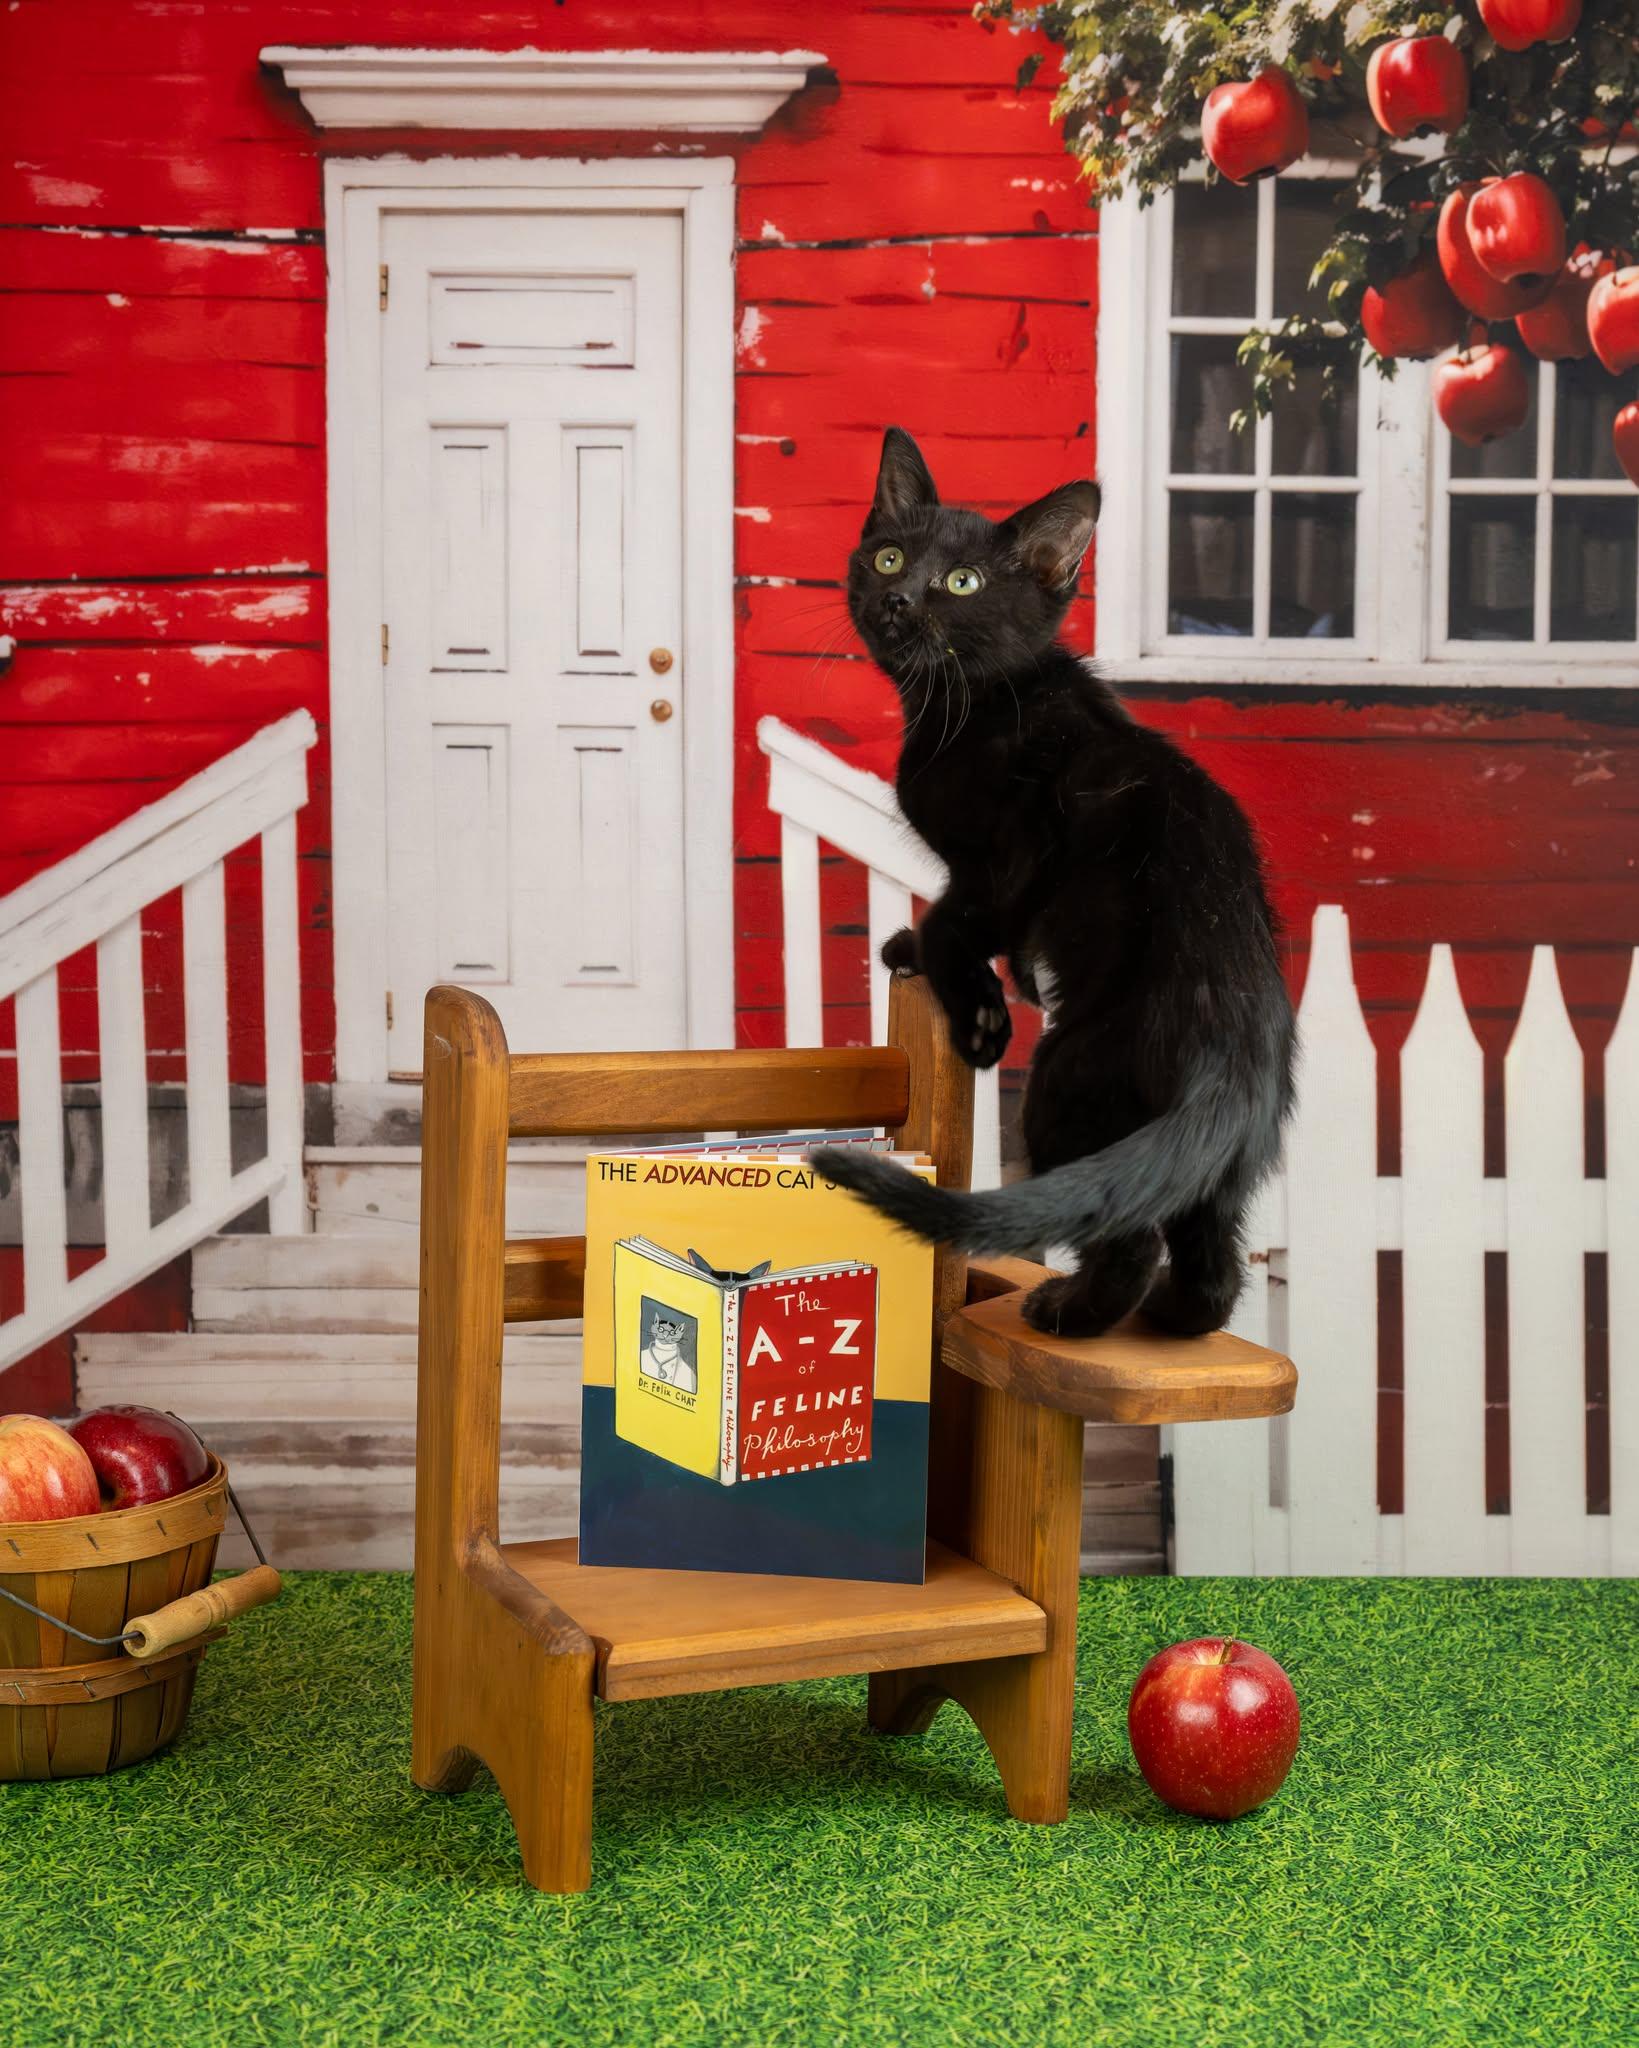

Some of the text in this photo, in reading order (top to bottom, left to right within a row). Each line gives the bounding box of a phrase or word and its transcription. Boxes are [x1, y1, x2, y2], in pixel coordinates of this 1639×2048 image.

[598, 1161, 637, 1182] THE
[643, 1163, 771, 1188] ADVANCED
[774, 1291, 831, 1316] The
[727, 1347, 734, 1356] of
[798, 1360, 815, 1374] of
[638, 1377, 697, 1407] Dr. Felix CHAT
[726, 1363, 734, 1400] FELINE
[751, 1385, 864, 1422] FELINE
[743, 1417, 865, 1465] Philosophy
